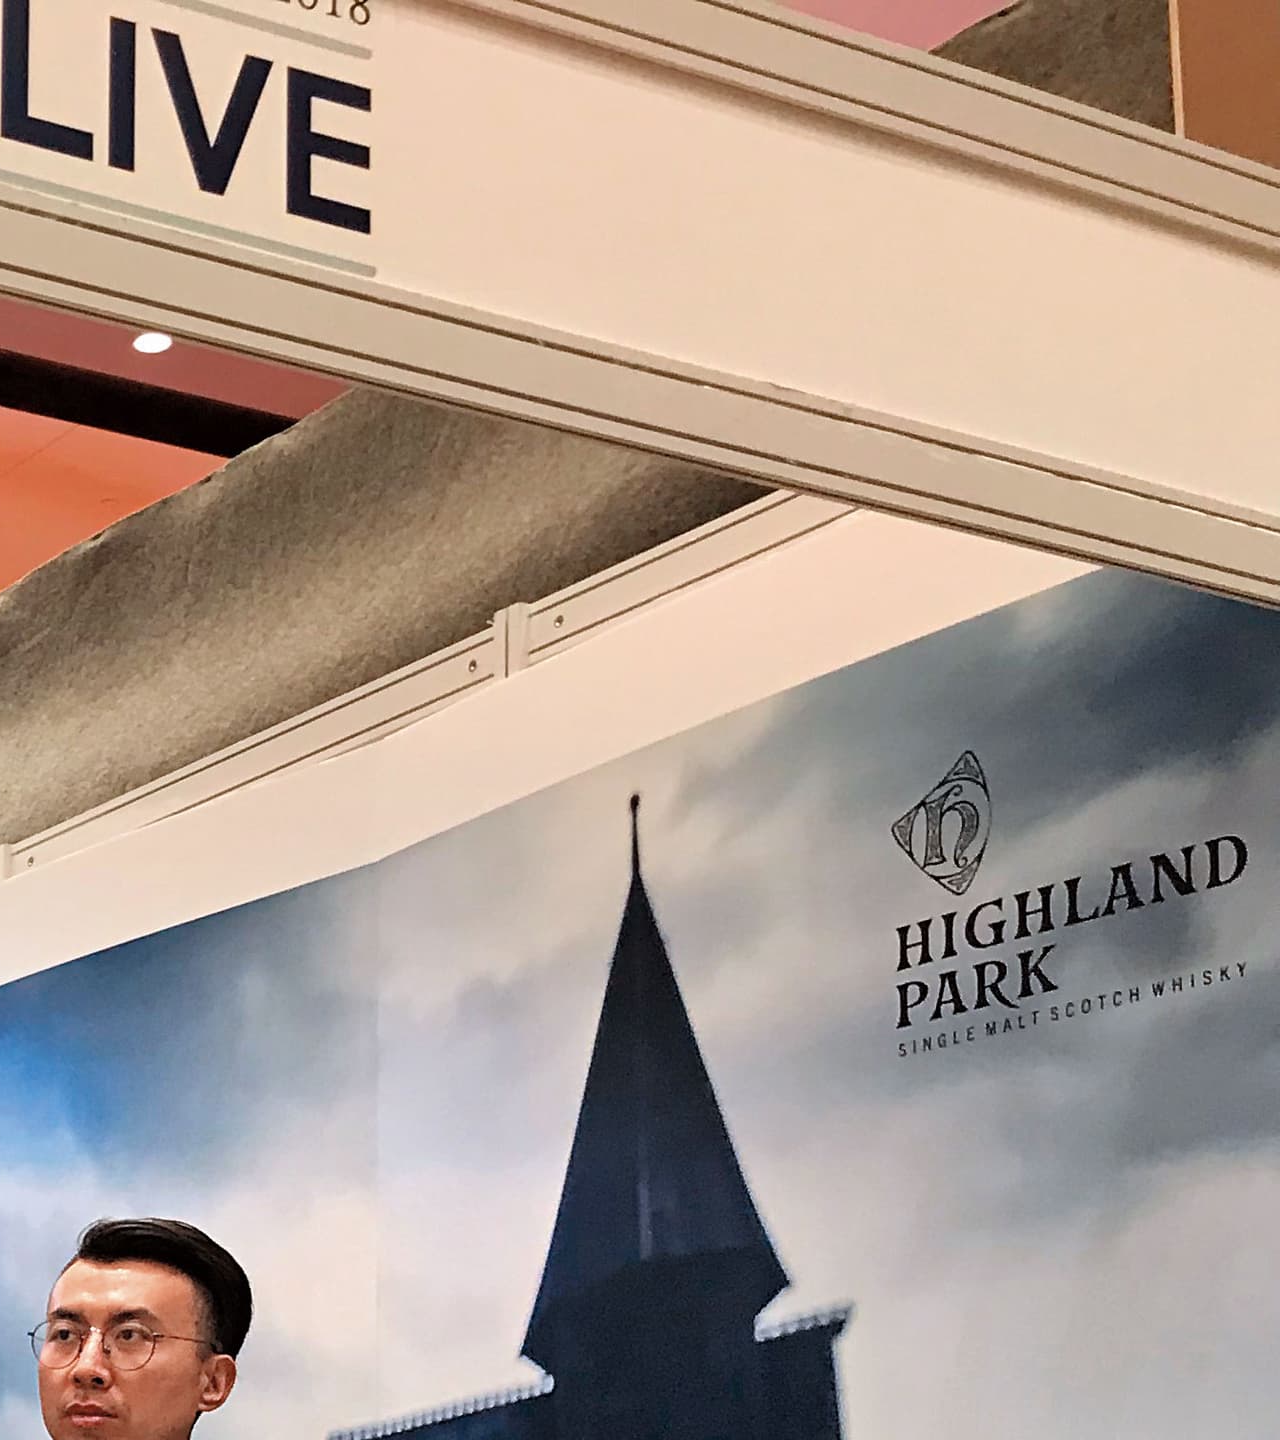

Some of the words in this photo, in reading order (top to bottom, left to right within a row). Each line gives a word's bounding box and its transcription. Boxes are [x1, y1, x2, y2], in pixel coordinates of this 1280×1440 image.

[0, 0, 372, 235] LIVE
[896, 835, 1249, 972] HIGHLAND
[896, 944, 1059, 1029] PARK
[898, 1026, 976, 1057] SINGLE
[985, 1010, 1041, 1037] MALT
[1050, 986, 1141, 1022] SCOTCH
[1152, 962, 1248, 998] WHISKY
